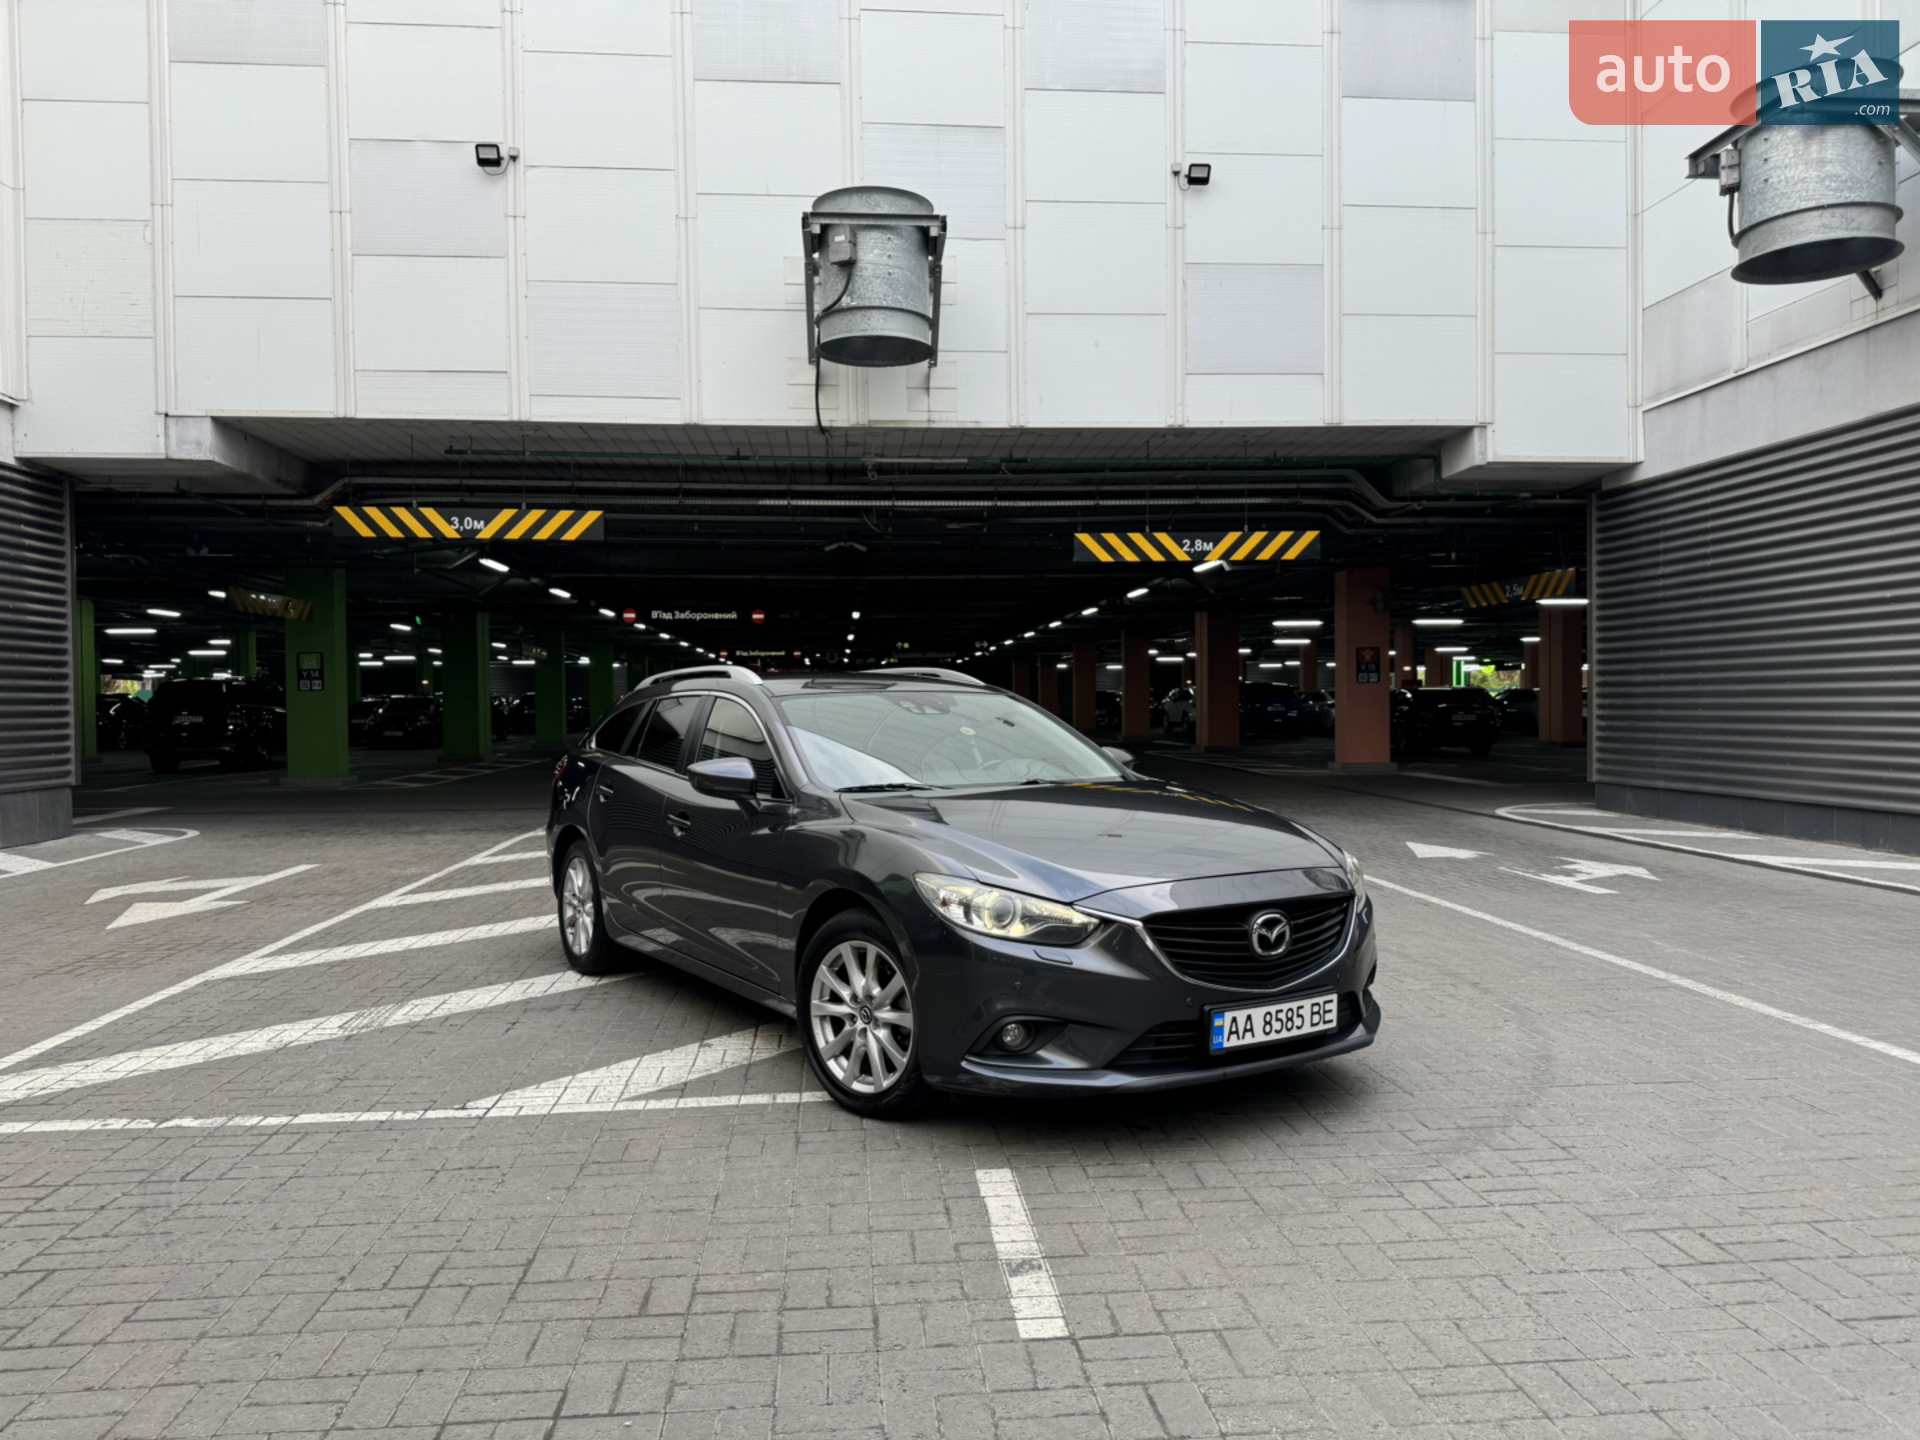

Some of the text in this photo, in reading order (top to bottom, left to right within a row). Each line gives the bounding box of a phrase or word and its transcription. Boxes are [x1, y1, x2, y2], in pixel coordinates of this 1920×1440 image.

[674, 609, 738, 621] Заборонений
[1226, 999, 1334, 1042] AA 8585 BE
